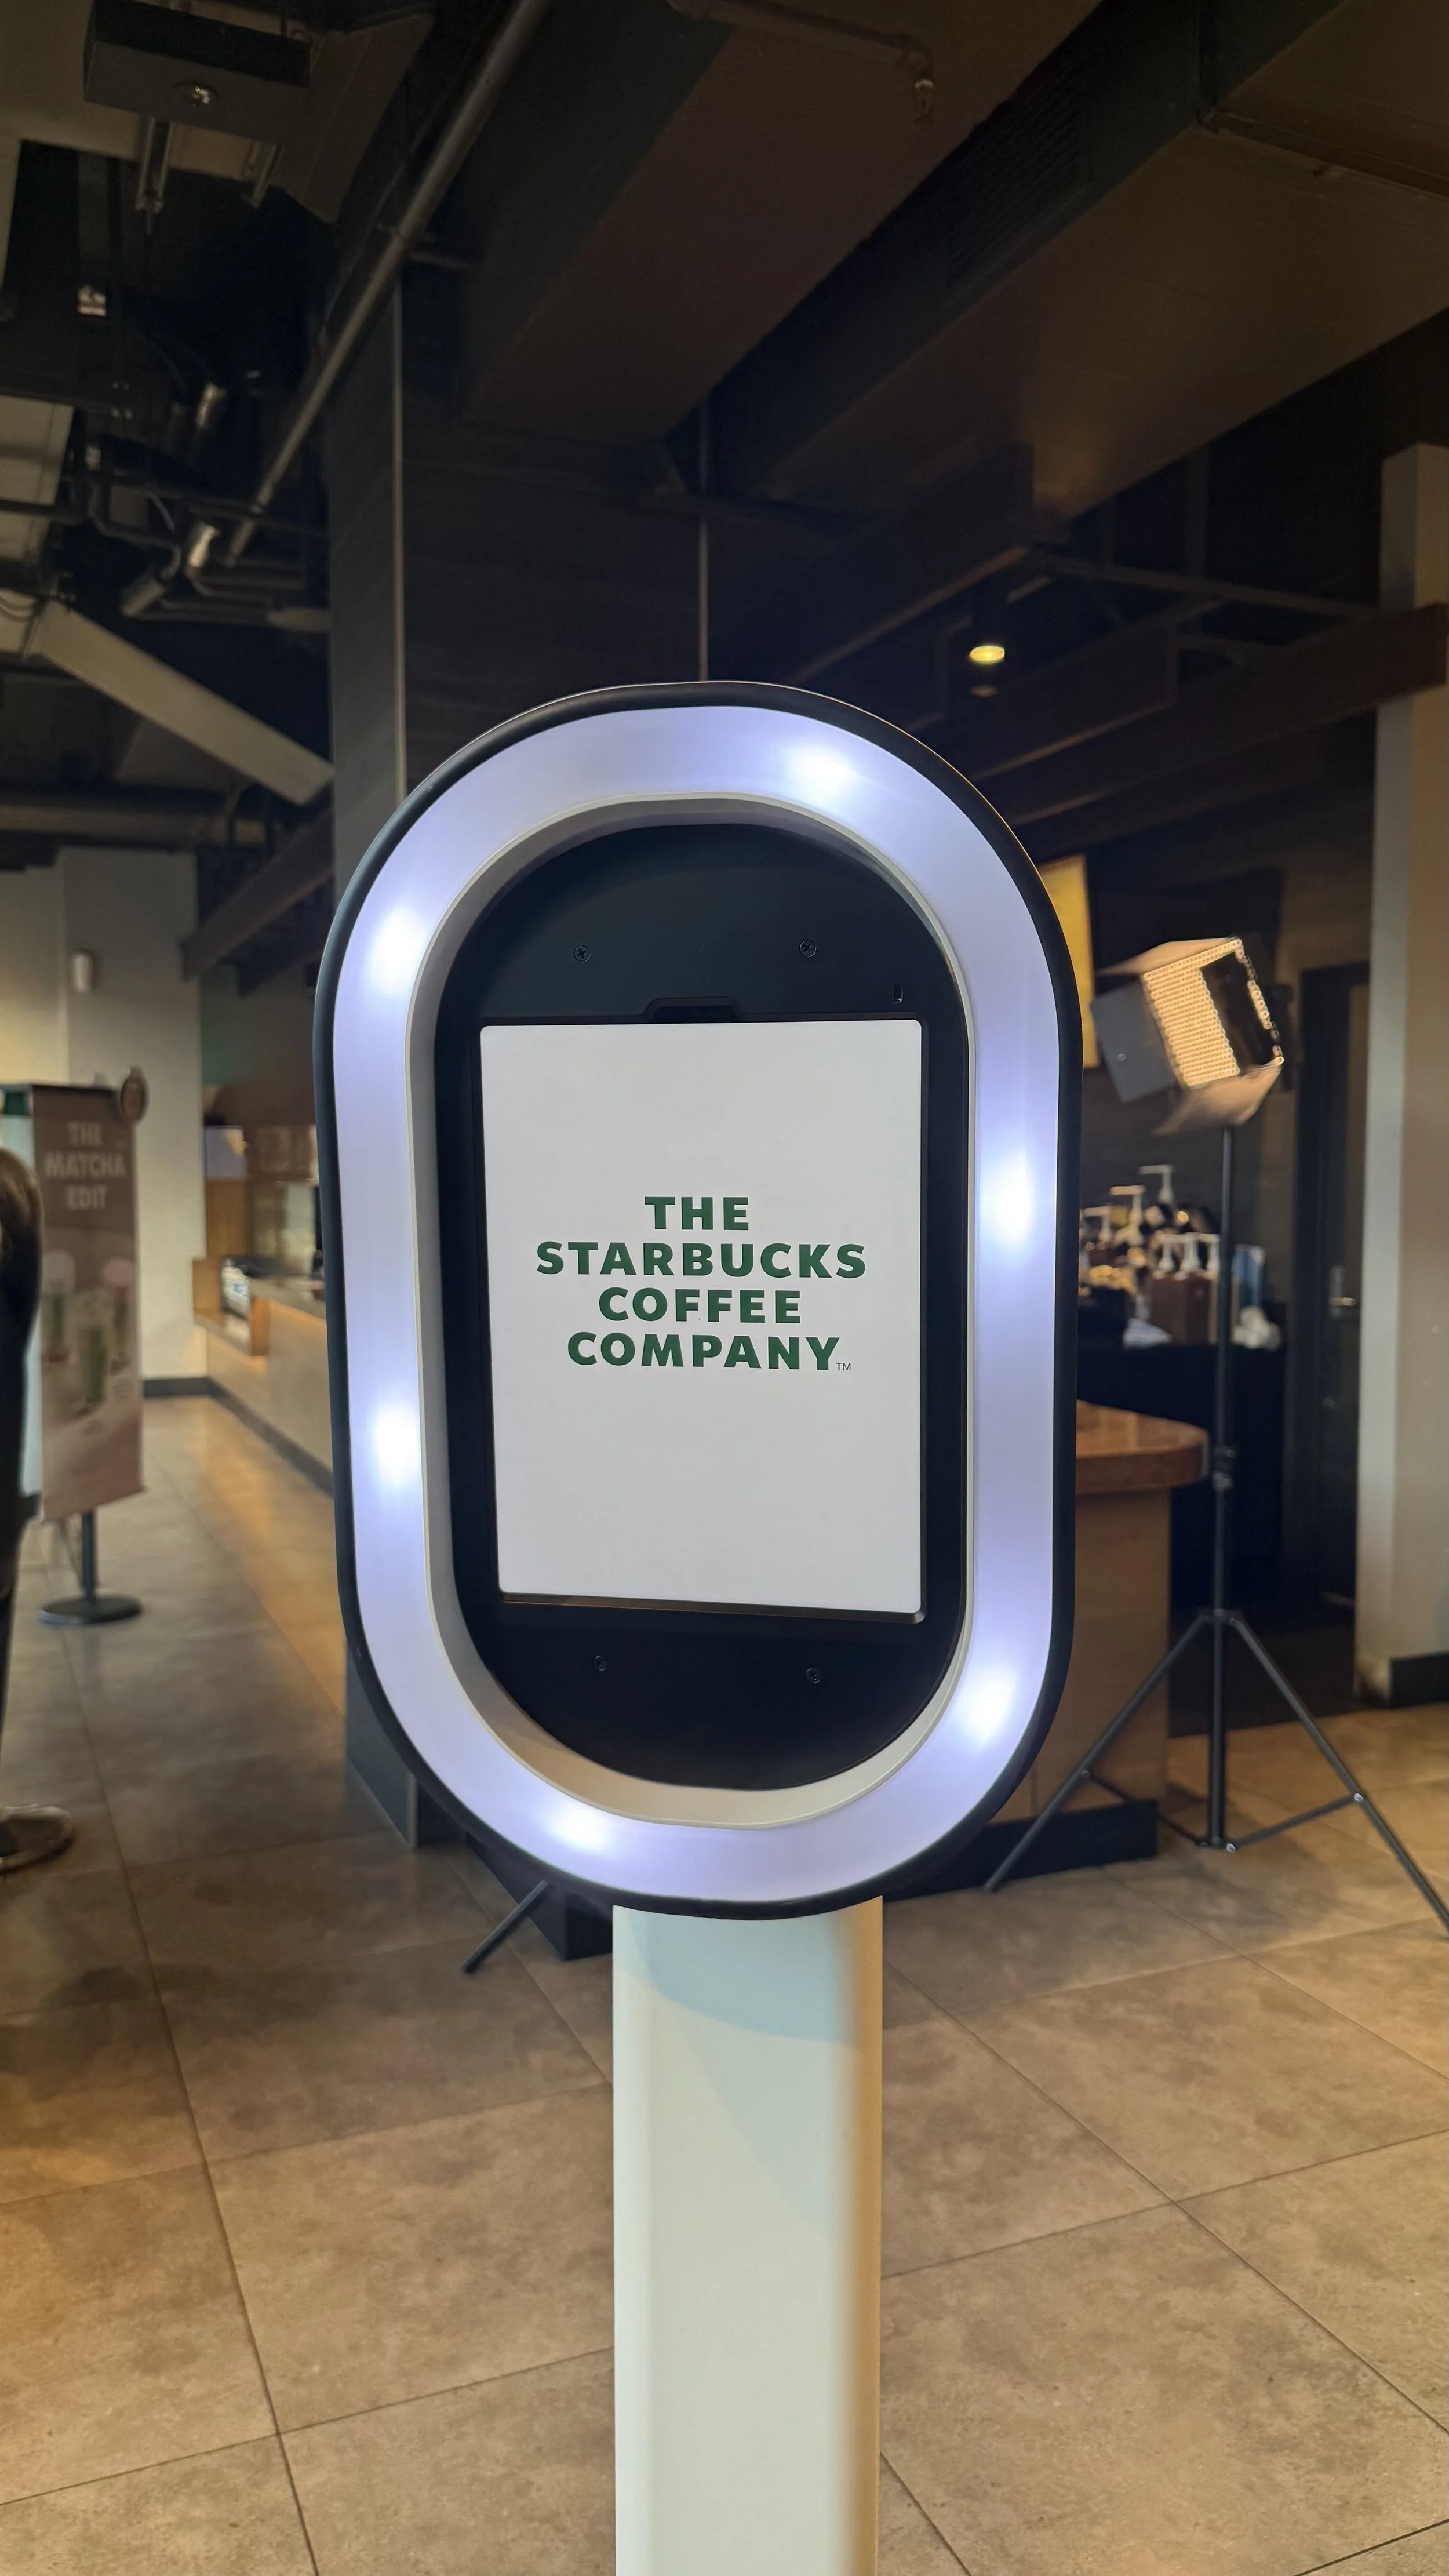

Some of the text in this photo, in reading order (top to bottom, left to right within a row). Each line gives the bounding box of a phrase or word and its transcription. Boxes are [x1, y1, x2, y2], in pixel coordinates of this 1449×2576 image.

[68, 1121, 104, 1146] THE
[46, 1151, 126, 1179] MATCHA
[67, 1185, 108, 1210] EDIT
[644, 1196, 749, 1231] THE
[537, 1241, 866, 1279] STARBUCKS
[599, 1287, 801, 1324] COFFEE
[567, 1331, 840, 1371] COMPANY
